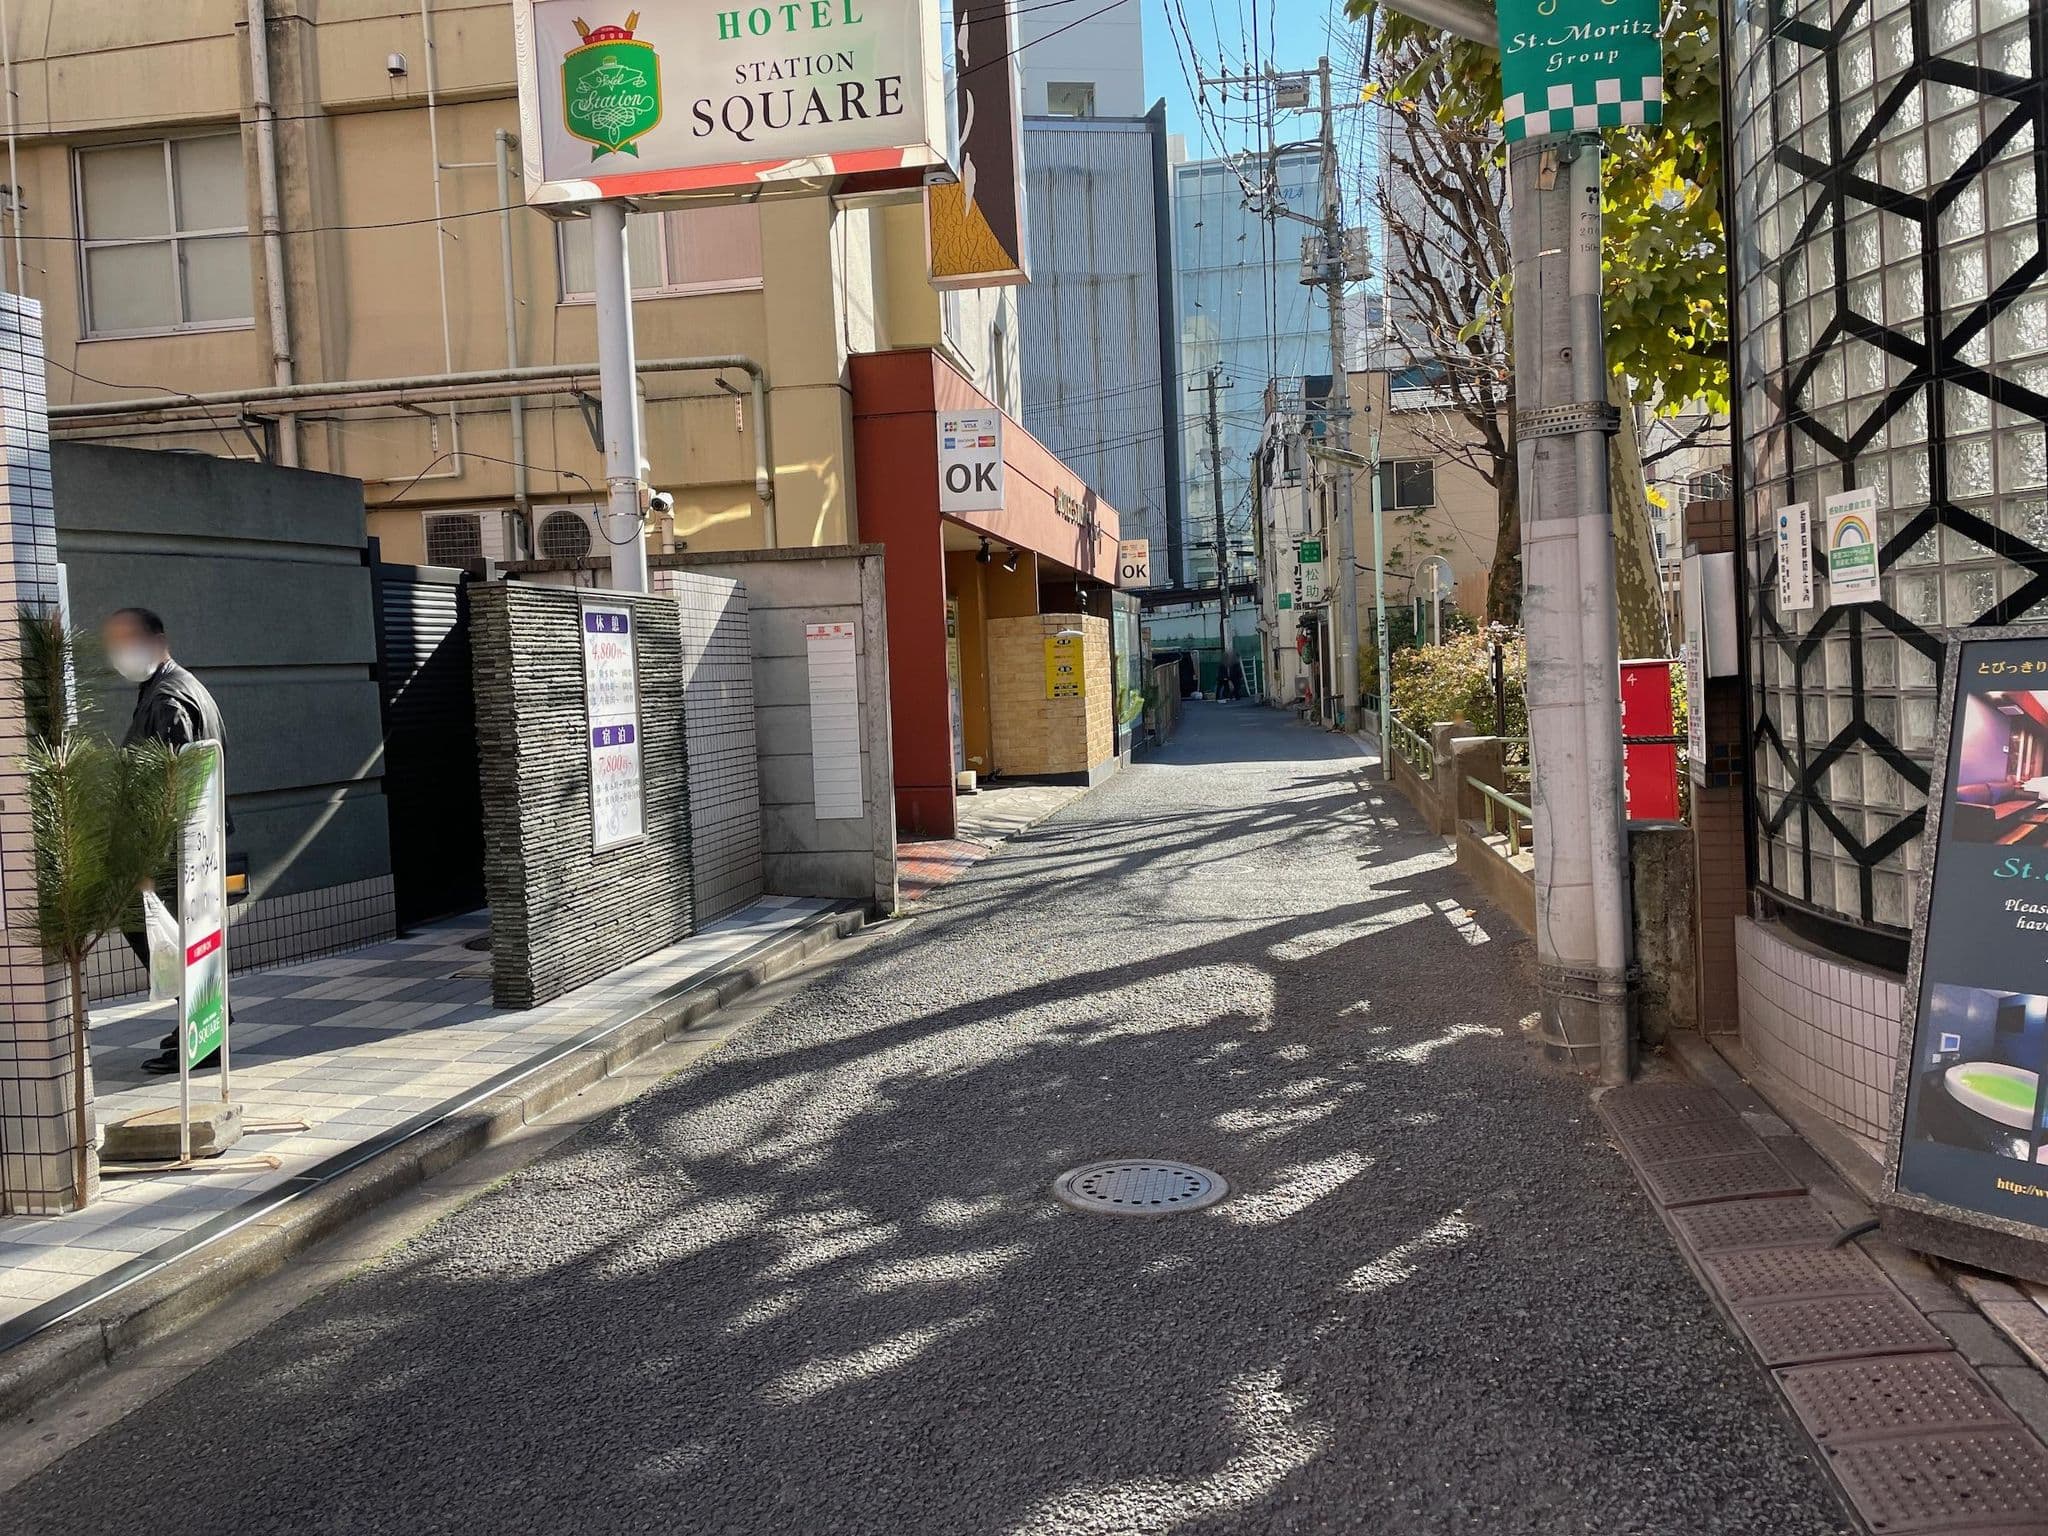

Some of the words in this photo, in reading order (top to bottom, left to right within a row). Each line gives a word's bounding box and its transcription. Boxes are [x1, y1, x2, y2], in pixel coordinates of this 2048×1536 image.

[715, 0, 864, 41] HOTEL
[735, 50, 855, 85] STATION
[1546, 49, 1619, 72] Group
[692, 75, 904, 142] SQUARE
[945, 461, 998, 494] OK
[1122, 563, 1147, 579] OK
[1306, 567, 1320, 598] 松助
[595, 614, 620, 633] 休憩
[1978, 660, 2047, 674] とびっきり
[1626, 672, 1638, 687] 4
[602, 725, 626, 745] 宿泊
[2004, 898, 2048, 915] Pleas
[198, 1016, 221, 1045] SQUARE
